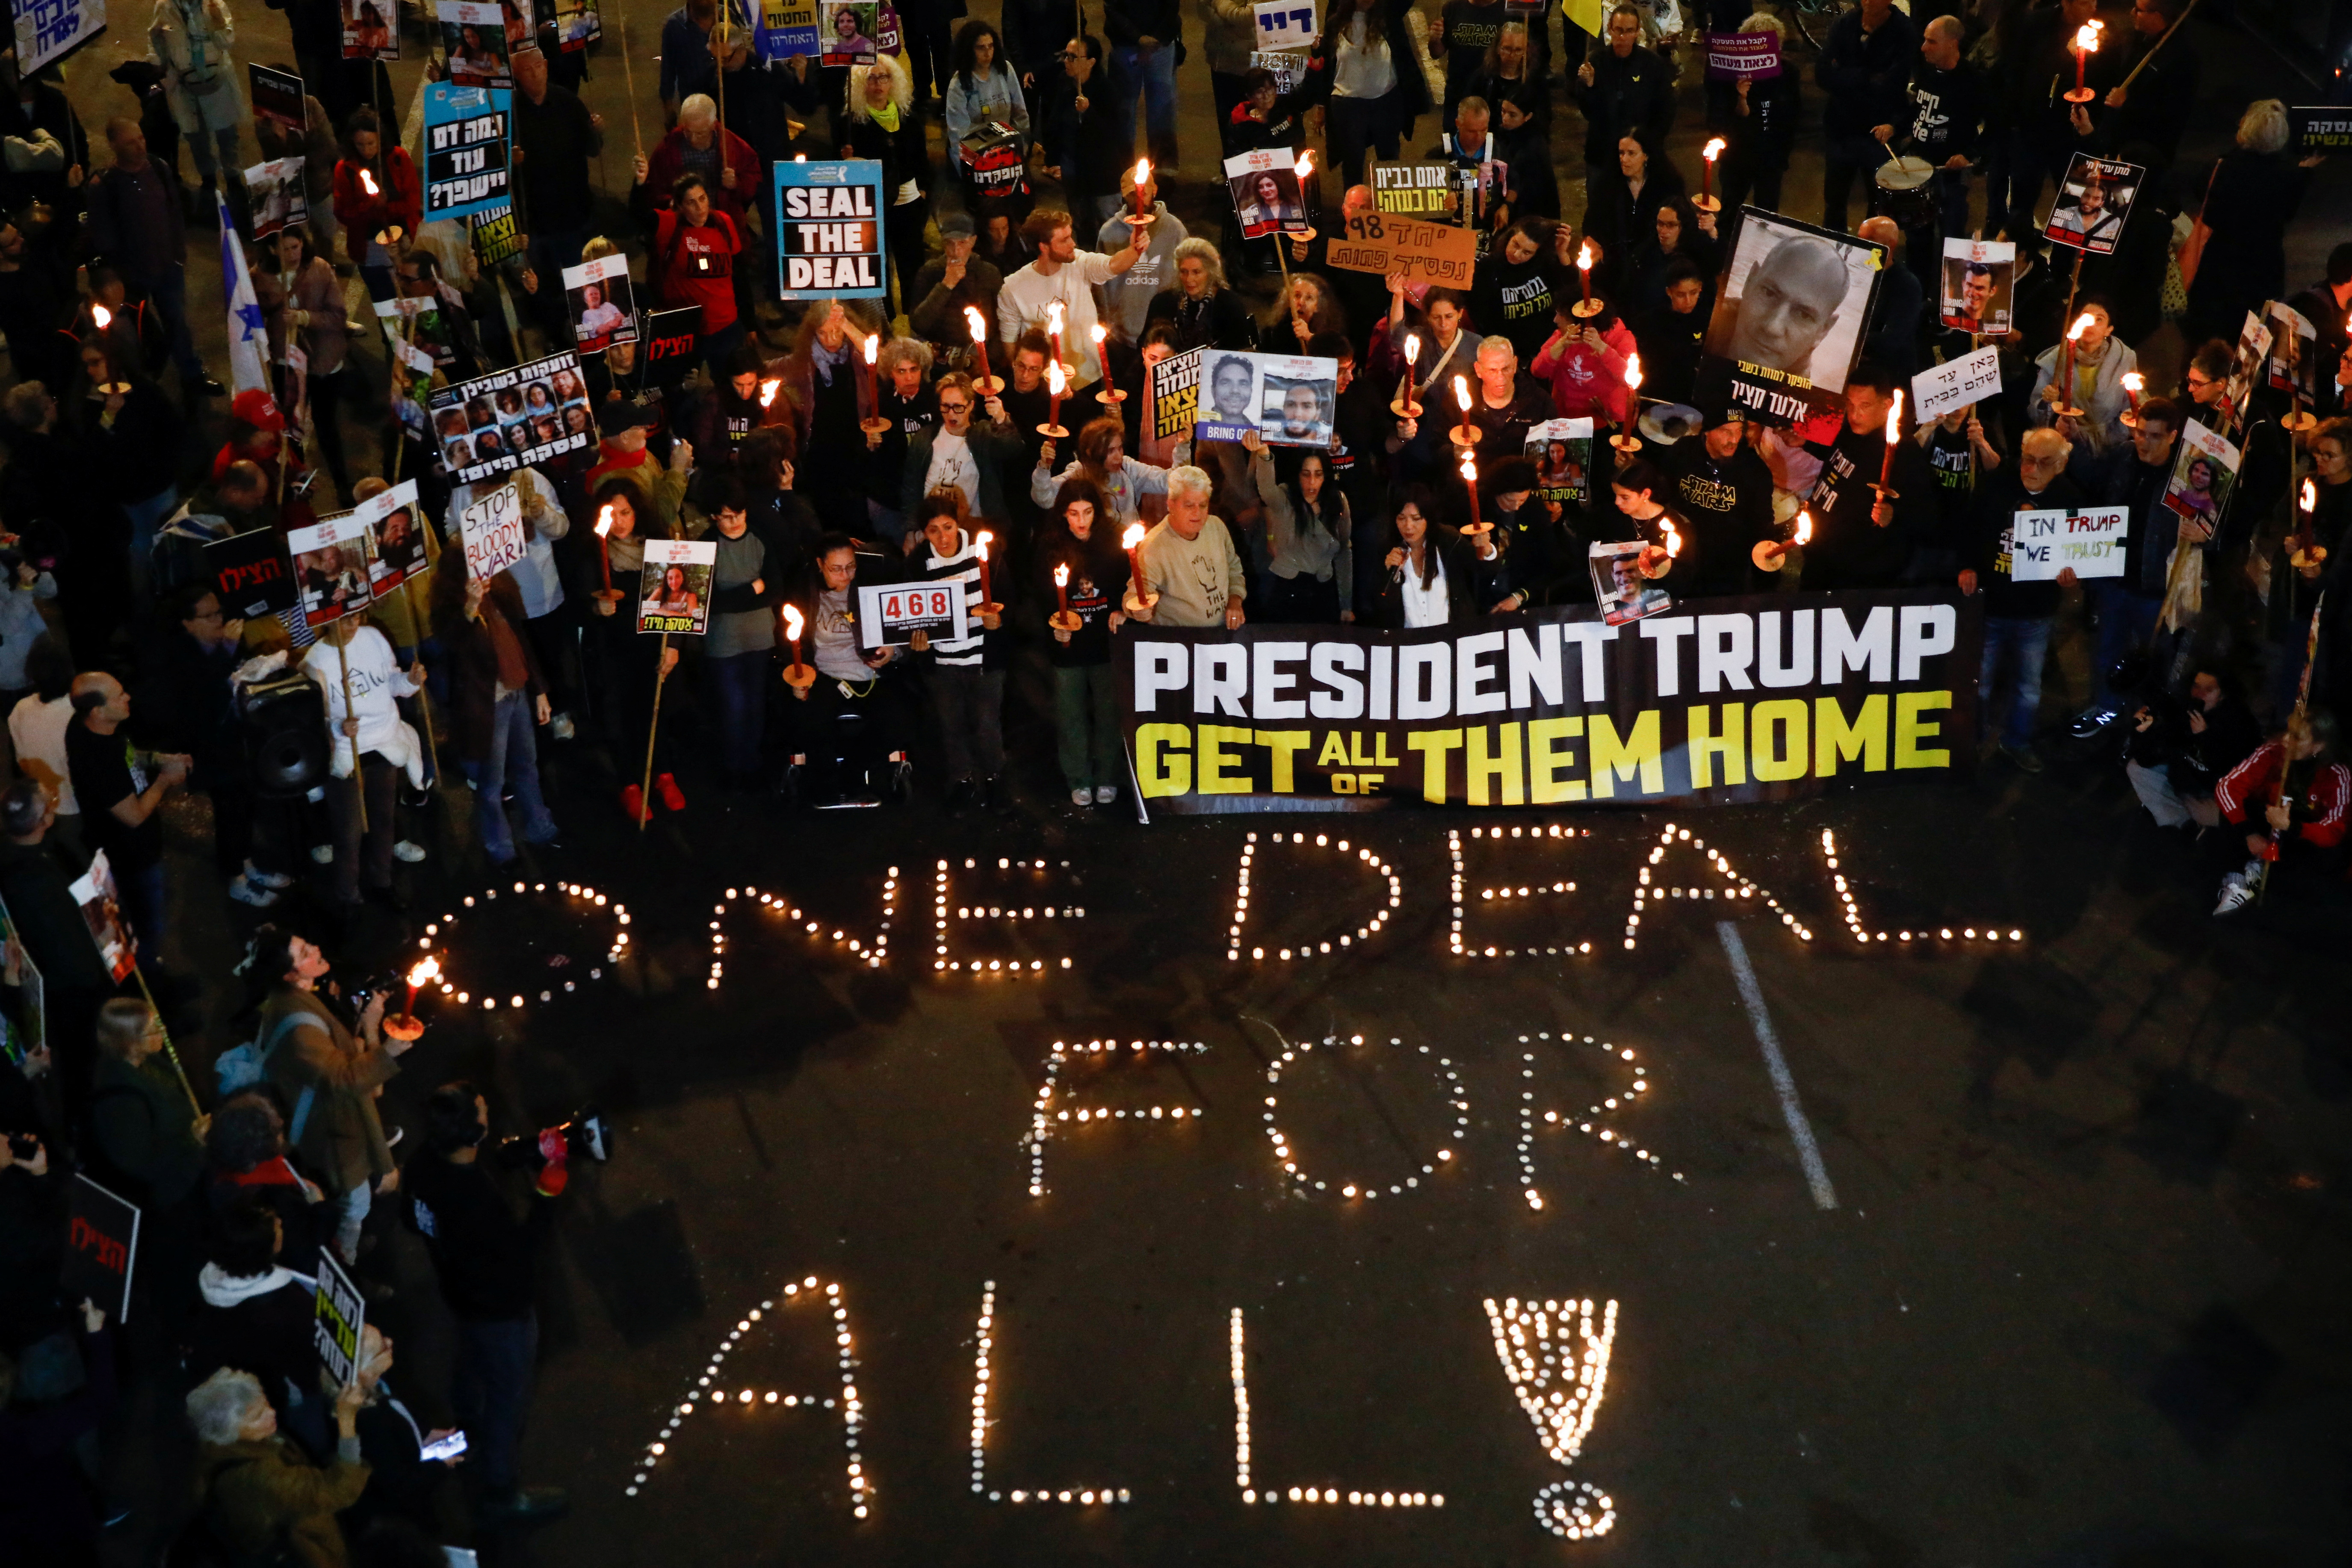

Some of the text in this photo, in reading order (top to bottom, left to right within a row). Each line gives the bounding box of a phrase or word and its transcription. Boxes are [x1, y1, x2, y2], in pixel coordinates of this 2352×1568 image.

[768, 11, 811, 27] החטוף
[1452, 24, 1497, 36] STAM
[1711, 56, 1773, 68] לצאת מעזה!
[433, 112, 503, 151] כמה דם
[2308, 121, 2352, 135] סקה
[451, 146, 485, 174] עוד
[2095, 162, 2114, 174] עדיין
[2114, 164, 2130, 176] מתן
[430, 171, 506, 209] יישפך?
[1376, 166, 1447, 189] אתם בבית
[786, 187, 873, 218] SEAL
[1241, 207, 1259, 219] BRING
[1377, 189, 1451, 213] הם בעזה!
[1242, 217, 1256, 226] HER
[2051, 217, 2065, 227] HIM
[2054, 208, 2074, 221] BRING
[798, 222, 862, 253] THE
[1349, 213, 1448, 248] יחד 98
[1331, 247, 1388, 269] פחות
[789, 257, 876, 289] DEAL
[1125, 275, 1160, 285] adidas
[1943, 307, 1956, 316] HIM
[1944, 298, 1963, 307] BRING
[649, 334, 694, 361] הצילו
[522, 352, 576, 382] זועקות
[1738, 360, 1812, 390] הופקר למוות בשבי
[461, 371, 519, 402] בשבילן
[1731, 379, 1808, 423] אלעד קציר
[1207, 426, 1235, 441] BRING
[458, 433, 588, 485] עסקה היום!
[1551, 487, 1579, 501] עסקה
[1680, 474, 1735, 500] STAM
[1681, 486, 1735, 511] WARS
[465, 485, 517, 533] STOP
[479, 513, 502, 534] THE
[2028, 514, 2122, 537] IN TRUMP
[467, 515, 522, 567] BLOODY
[2026, 546, 2050, 562] WE
[2061, 540, 2117, 560] TRUST
[474, 538, 524, 582] WAR!
[219, 557, 281, 594] הצילו
[886, 592, 946, 619] 468
[1206, 591, 1224, 605] THE
[1601, 591, 1619, 605] BRING
[1603, 603, 1616, 614] HIM
[664, 616, 694, 631] עסקה
[1640, 603, 1956, 697] TRUMP
[1134, 623, 1619, 720] PRESIDENT
[1135, 722, 1399, 798] GET ALL
[1407, 690, 1952, 806] THEM HOME
[1331, 773, 1384, 794] OF
[421, 822, 2023, 1008] ONE DEAL
[1027, 1030, 1686, 1210] FOR
[71, 1216, 127, 1275] הצילו
